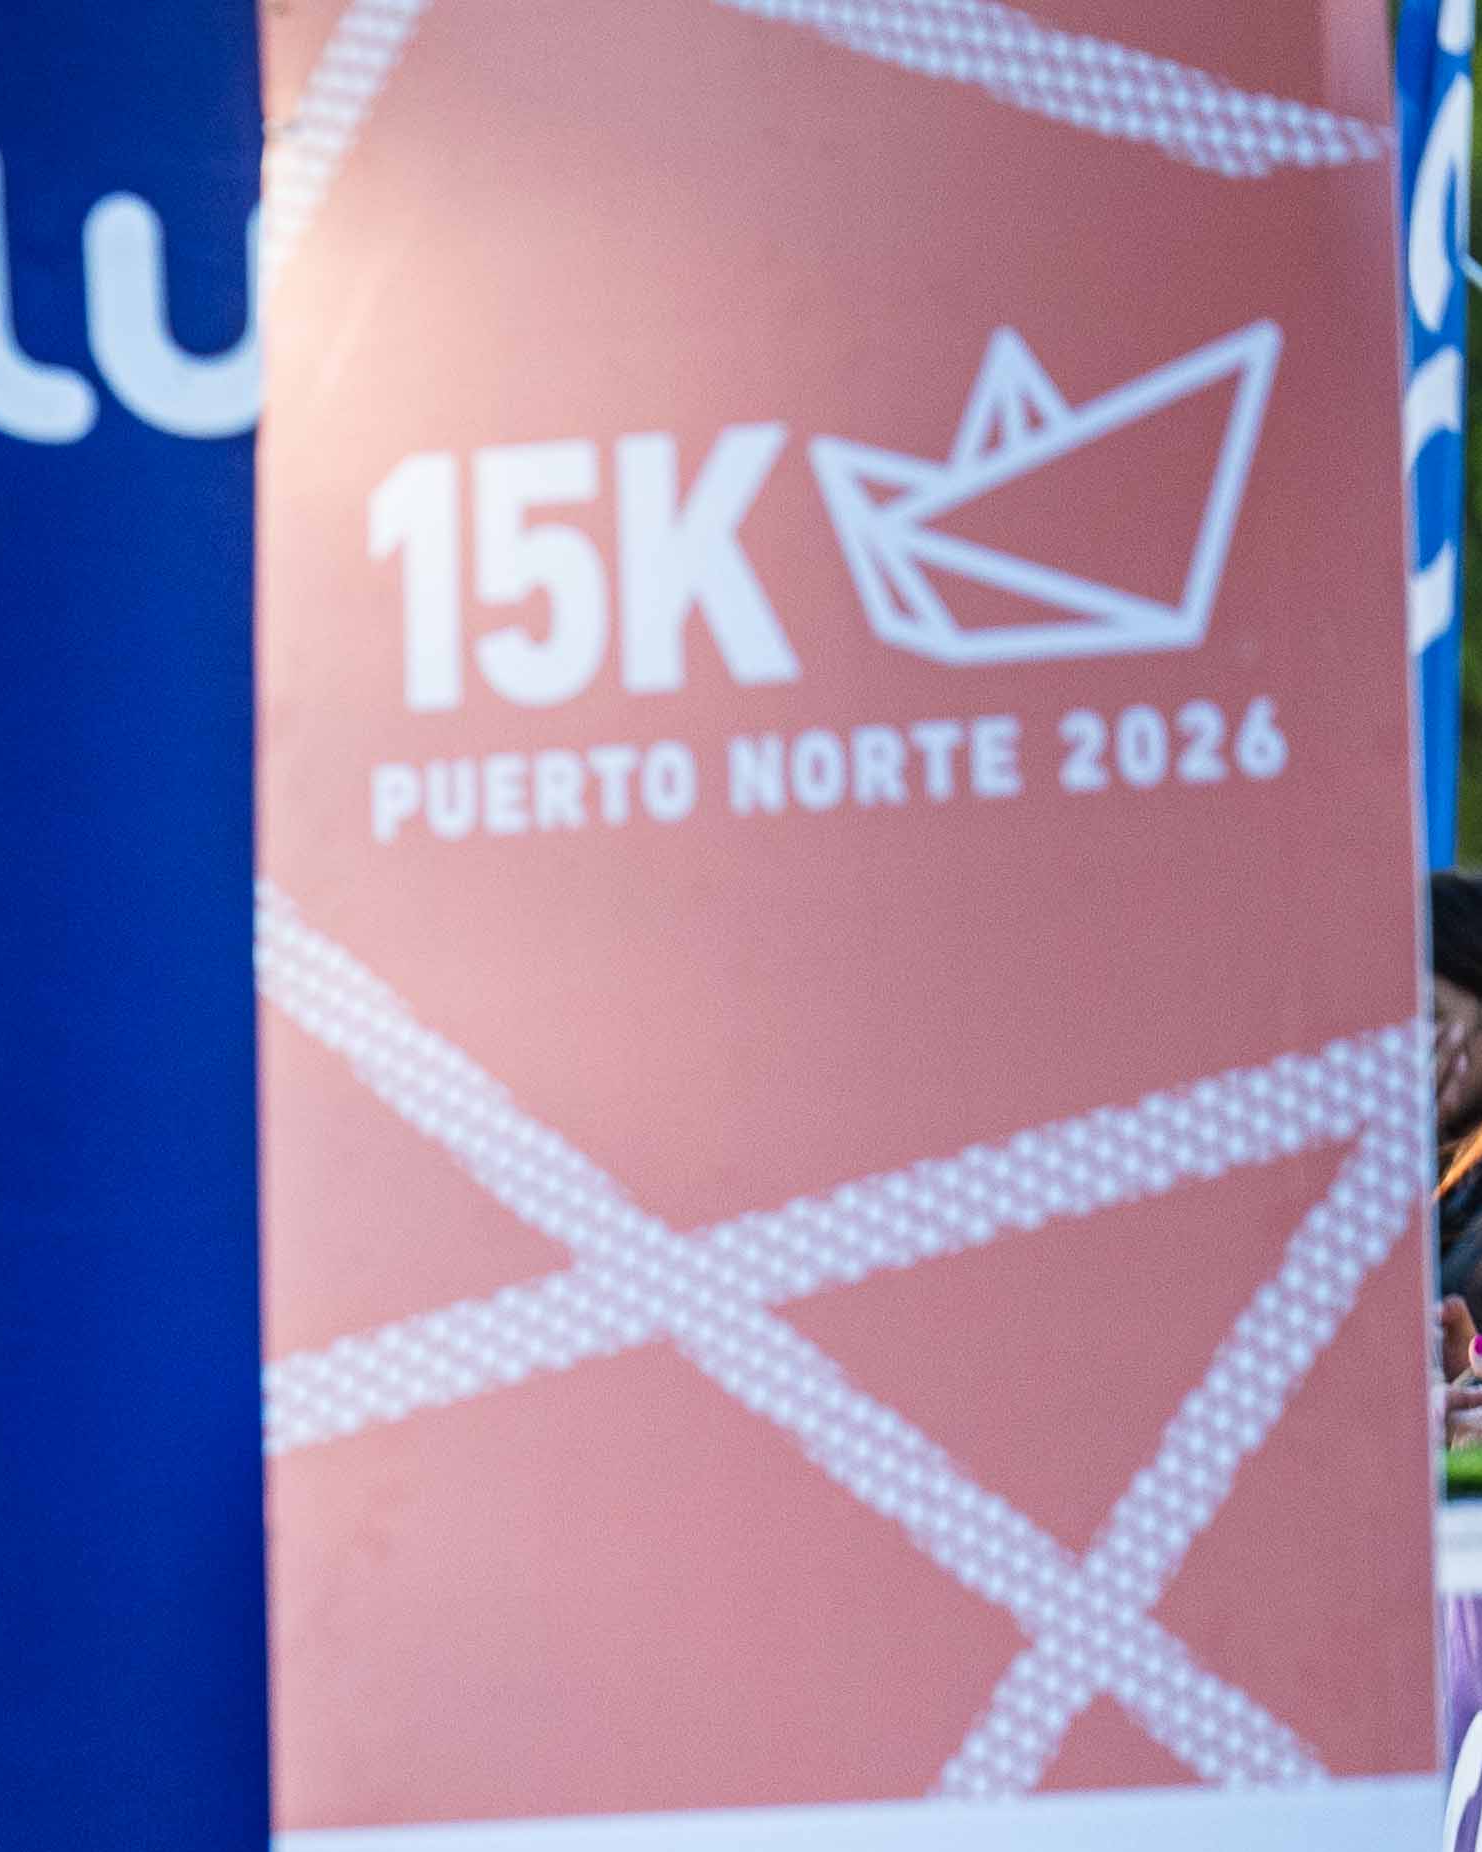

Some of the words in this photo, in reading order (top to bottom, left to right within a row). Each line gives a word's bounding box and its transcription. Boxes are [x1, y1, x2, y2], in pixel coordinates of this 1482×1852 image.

[362, 421, 800, 713] 15K
[371, 741, 697, 843] PUERTO
[729, 714, 1021, 815] NORTE
[1061, 697, 1288, 790] 2026
